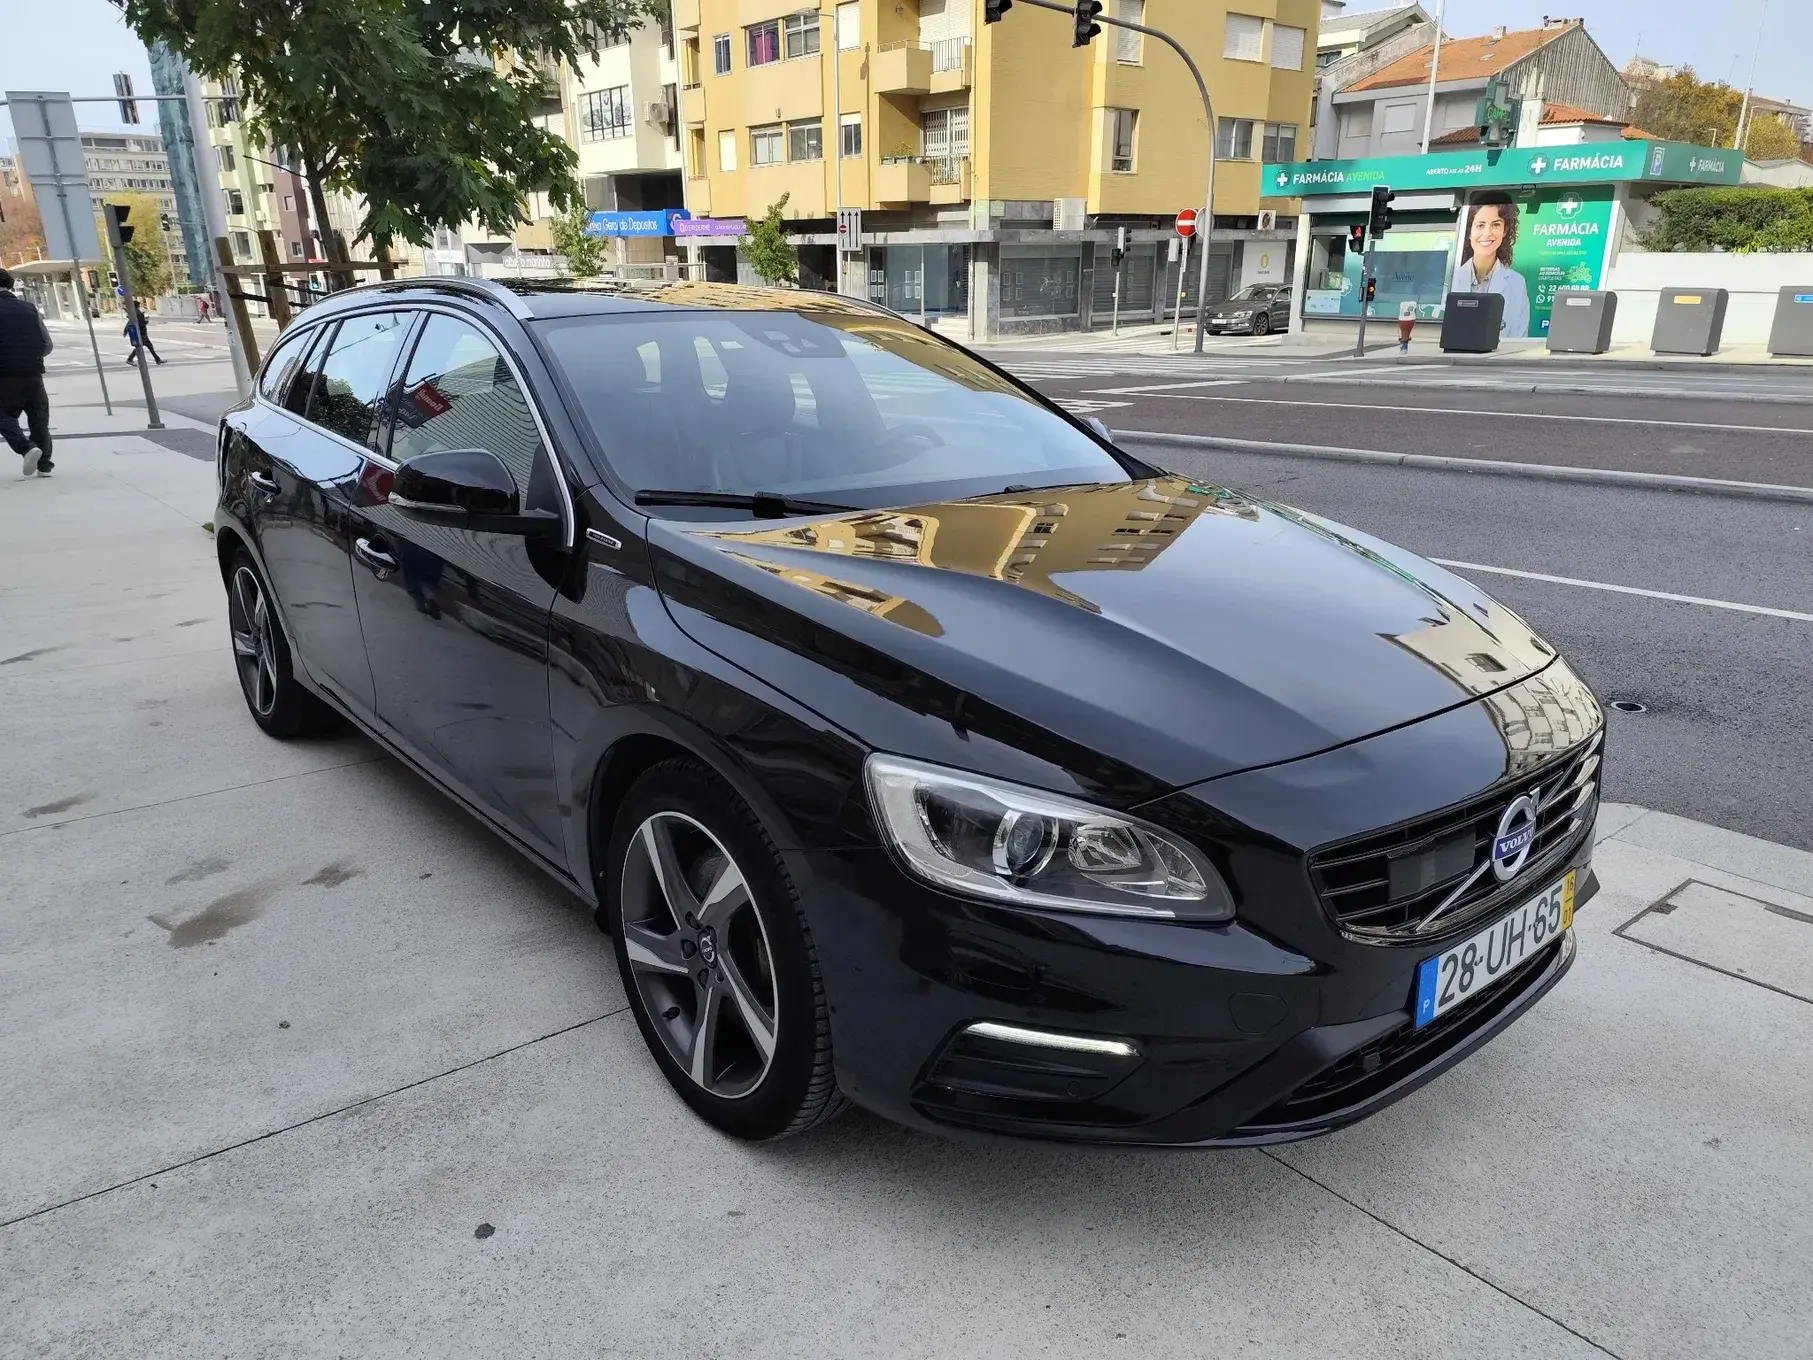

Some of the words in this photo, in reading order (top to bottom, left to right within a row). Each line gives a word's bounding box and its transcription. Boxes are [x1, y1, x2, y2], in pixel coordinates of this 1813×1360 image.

[1425, 167, 1448, 175] ABERTO
[1464, 164, 1482, 174] 24H
[1553, 153, 1624, 171] FARMÁCIA
[1698, 157, 1725, 173] FARMÁCIA
[1293, 169, 1345, 184] FARMÁCIA
[1346, 170, 1385, 182] AVENIDA
[602, 218, 618, 230] Geral
[620, 219, 627, 230] de
[1533, 221, 1599, 235] FARMÁCIA
[1546, 239, 1582, 247] AVENIDA
[1499, 827, 1534, 852] VOLVO
[1566, 876, 1574, 891] 16
[1562, 908, 1572, 925] 01
[1422, 998, 1430, 1014] P
